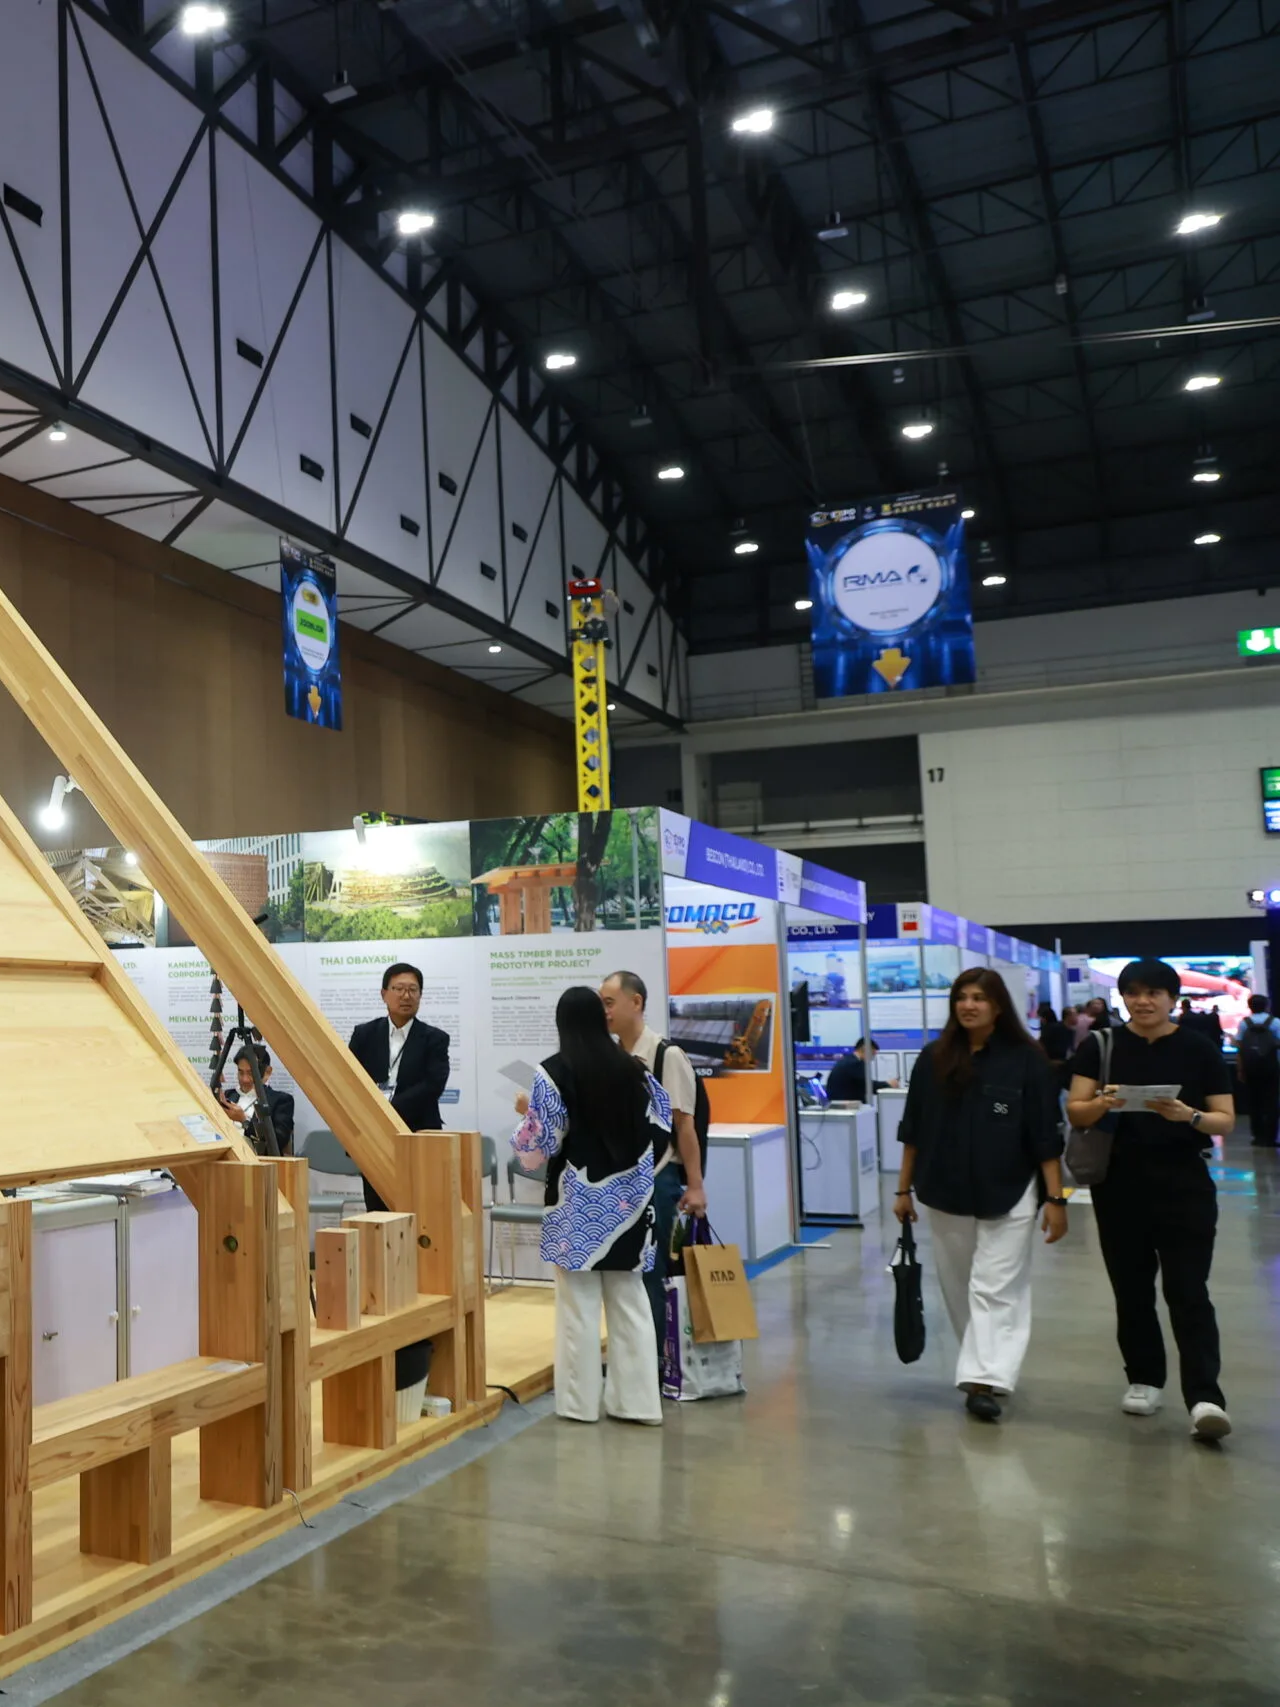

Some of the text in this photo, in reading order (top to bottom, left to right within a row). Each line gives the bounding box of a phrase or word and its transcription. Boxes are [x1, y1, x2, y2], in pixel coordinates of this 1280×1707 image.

[843, 570, 902, 588] RMA
[928, 768, 944, 782] 17
[664, 902, 756, 924] OMACO
[814, 926, 838, 934] LTD.
[577, 948, 602, 956] STOP
[320, 955, 398, 965] THAI OBAYASHI
[490, 959, 591, 970] PROTOTYPE PROJECT
[710, 1270, 735, 1282] ATAD
